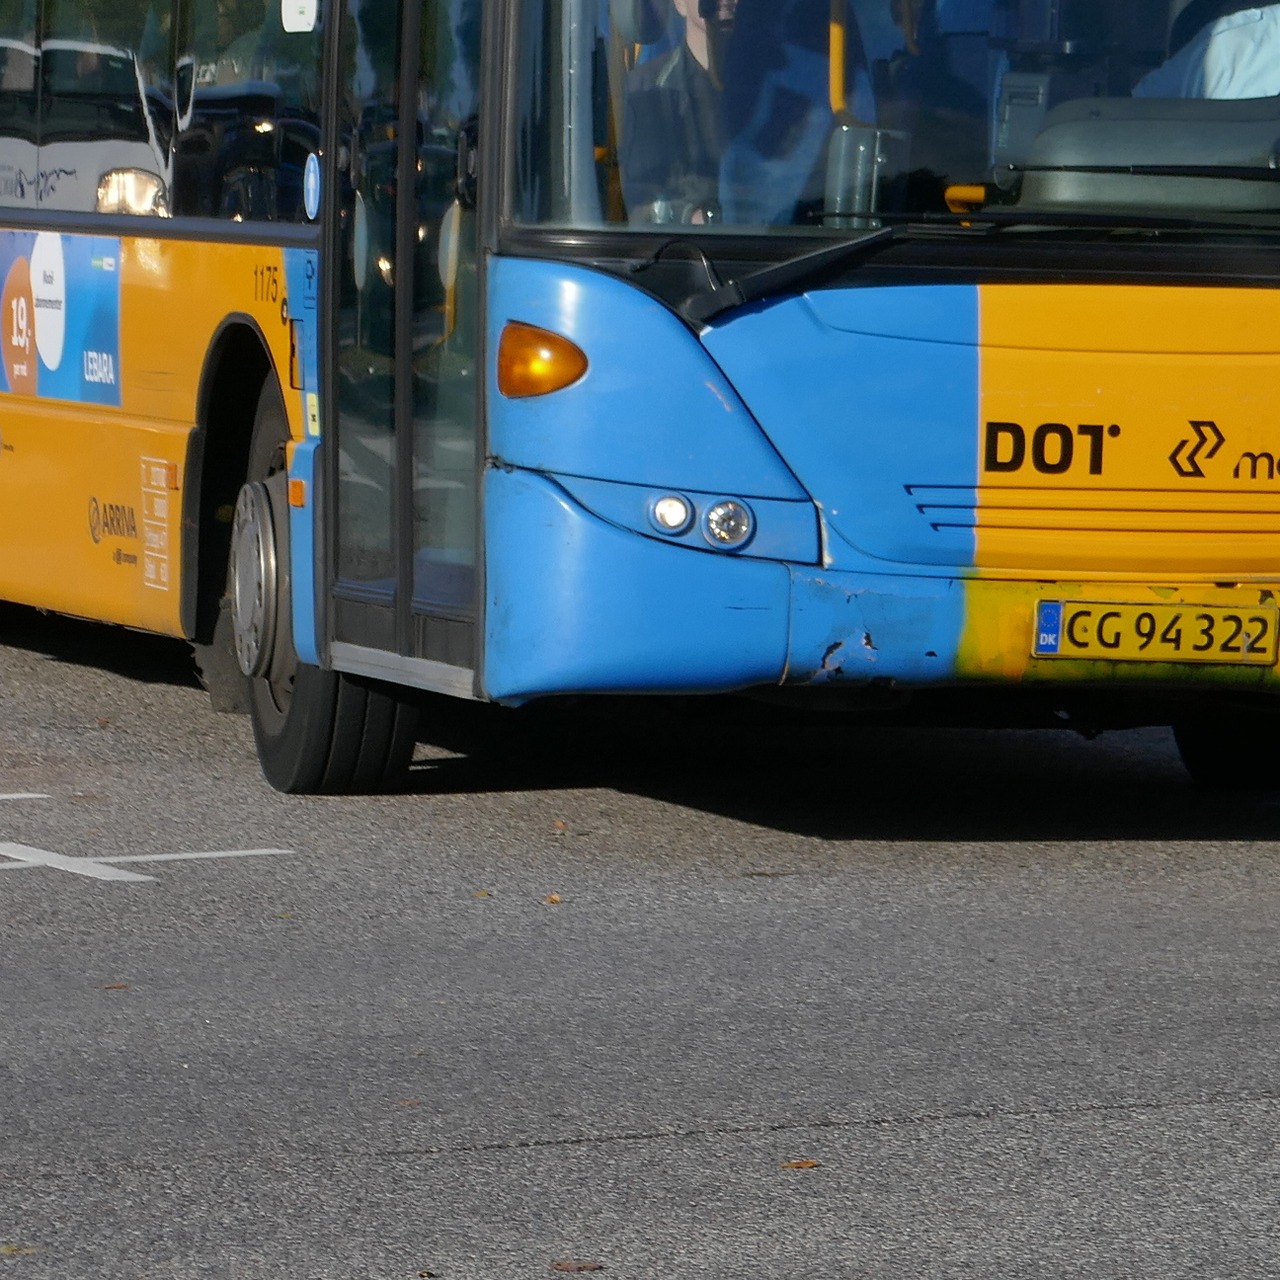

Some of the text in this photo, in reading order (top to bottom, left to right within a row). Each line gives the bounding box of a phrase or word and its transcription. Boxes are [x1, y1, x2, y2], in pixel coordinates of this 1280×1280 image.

[254, 264, 279, 304] 1175
[83, 350, 115, 385] LEBARA
[984, 421, 1120, 476] DOT
[102, 503, 138, 539] ARRIVA
[1040, 633, 1056, 646] DK
[1067, 610, 1269, 654] CG 94 322
